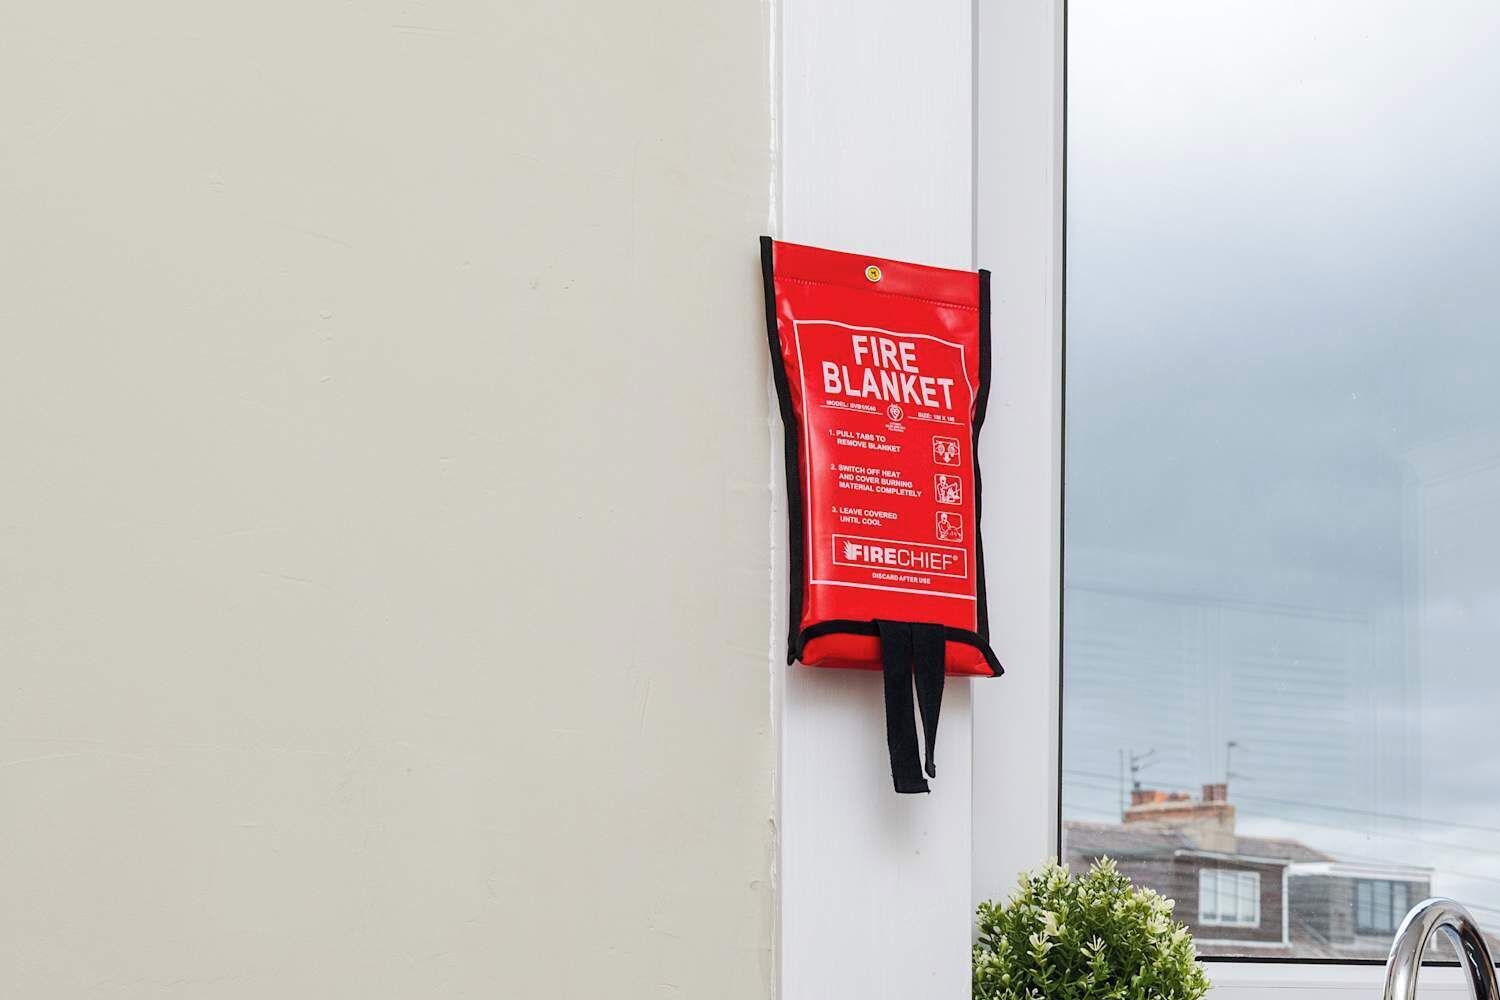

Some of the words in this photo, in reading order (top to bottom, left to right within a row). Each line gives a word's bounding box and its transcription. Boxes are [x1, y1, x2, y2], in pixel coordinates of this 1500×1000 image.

[852, 335, 920, 373] FIRE
[822, 361, 954, 410] BLANKET
[836, 430, 854, 438] PULL
[856, 432, 875, 441] TABS
[837, 438, 867, 448] REMOVE
[868, 442, 901, 452] BLANKET
[838, 464, 865, 474] SWITCH
[867, 467, 880, 476] OFF
[882, 470, 901, 478] HEAT
[839, 473, 854, 481] AND
[855, 475, 881, 484] COVER
[881, 479, 912, 488] BURNING
[839, 482, 874, 492] MATERIAL
[875, 486, 922, 497] COMPLETELY
[840, 507, 862, 516] LEAVE
[864, 510, 897, 519] COVERED
[840, 516, 861, 524] UNTIL
[862, 518, 882, 526] COOL
[872, 572, 898, 581] DISCARD
[899, 575, 918, 583] AFTER
